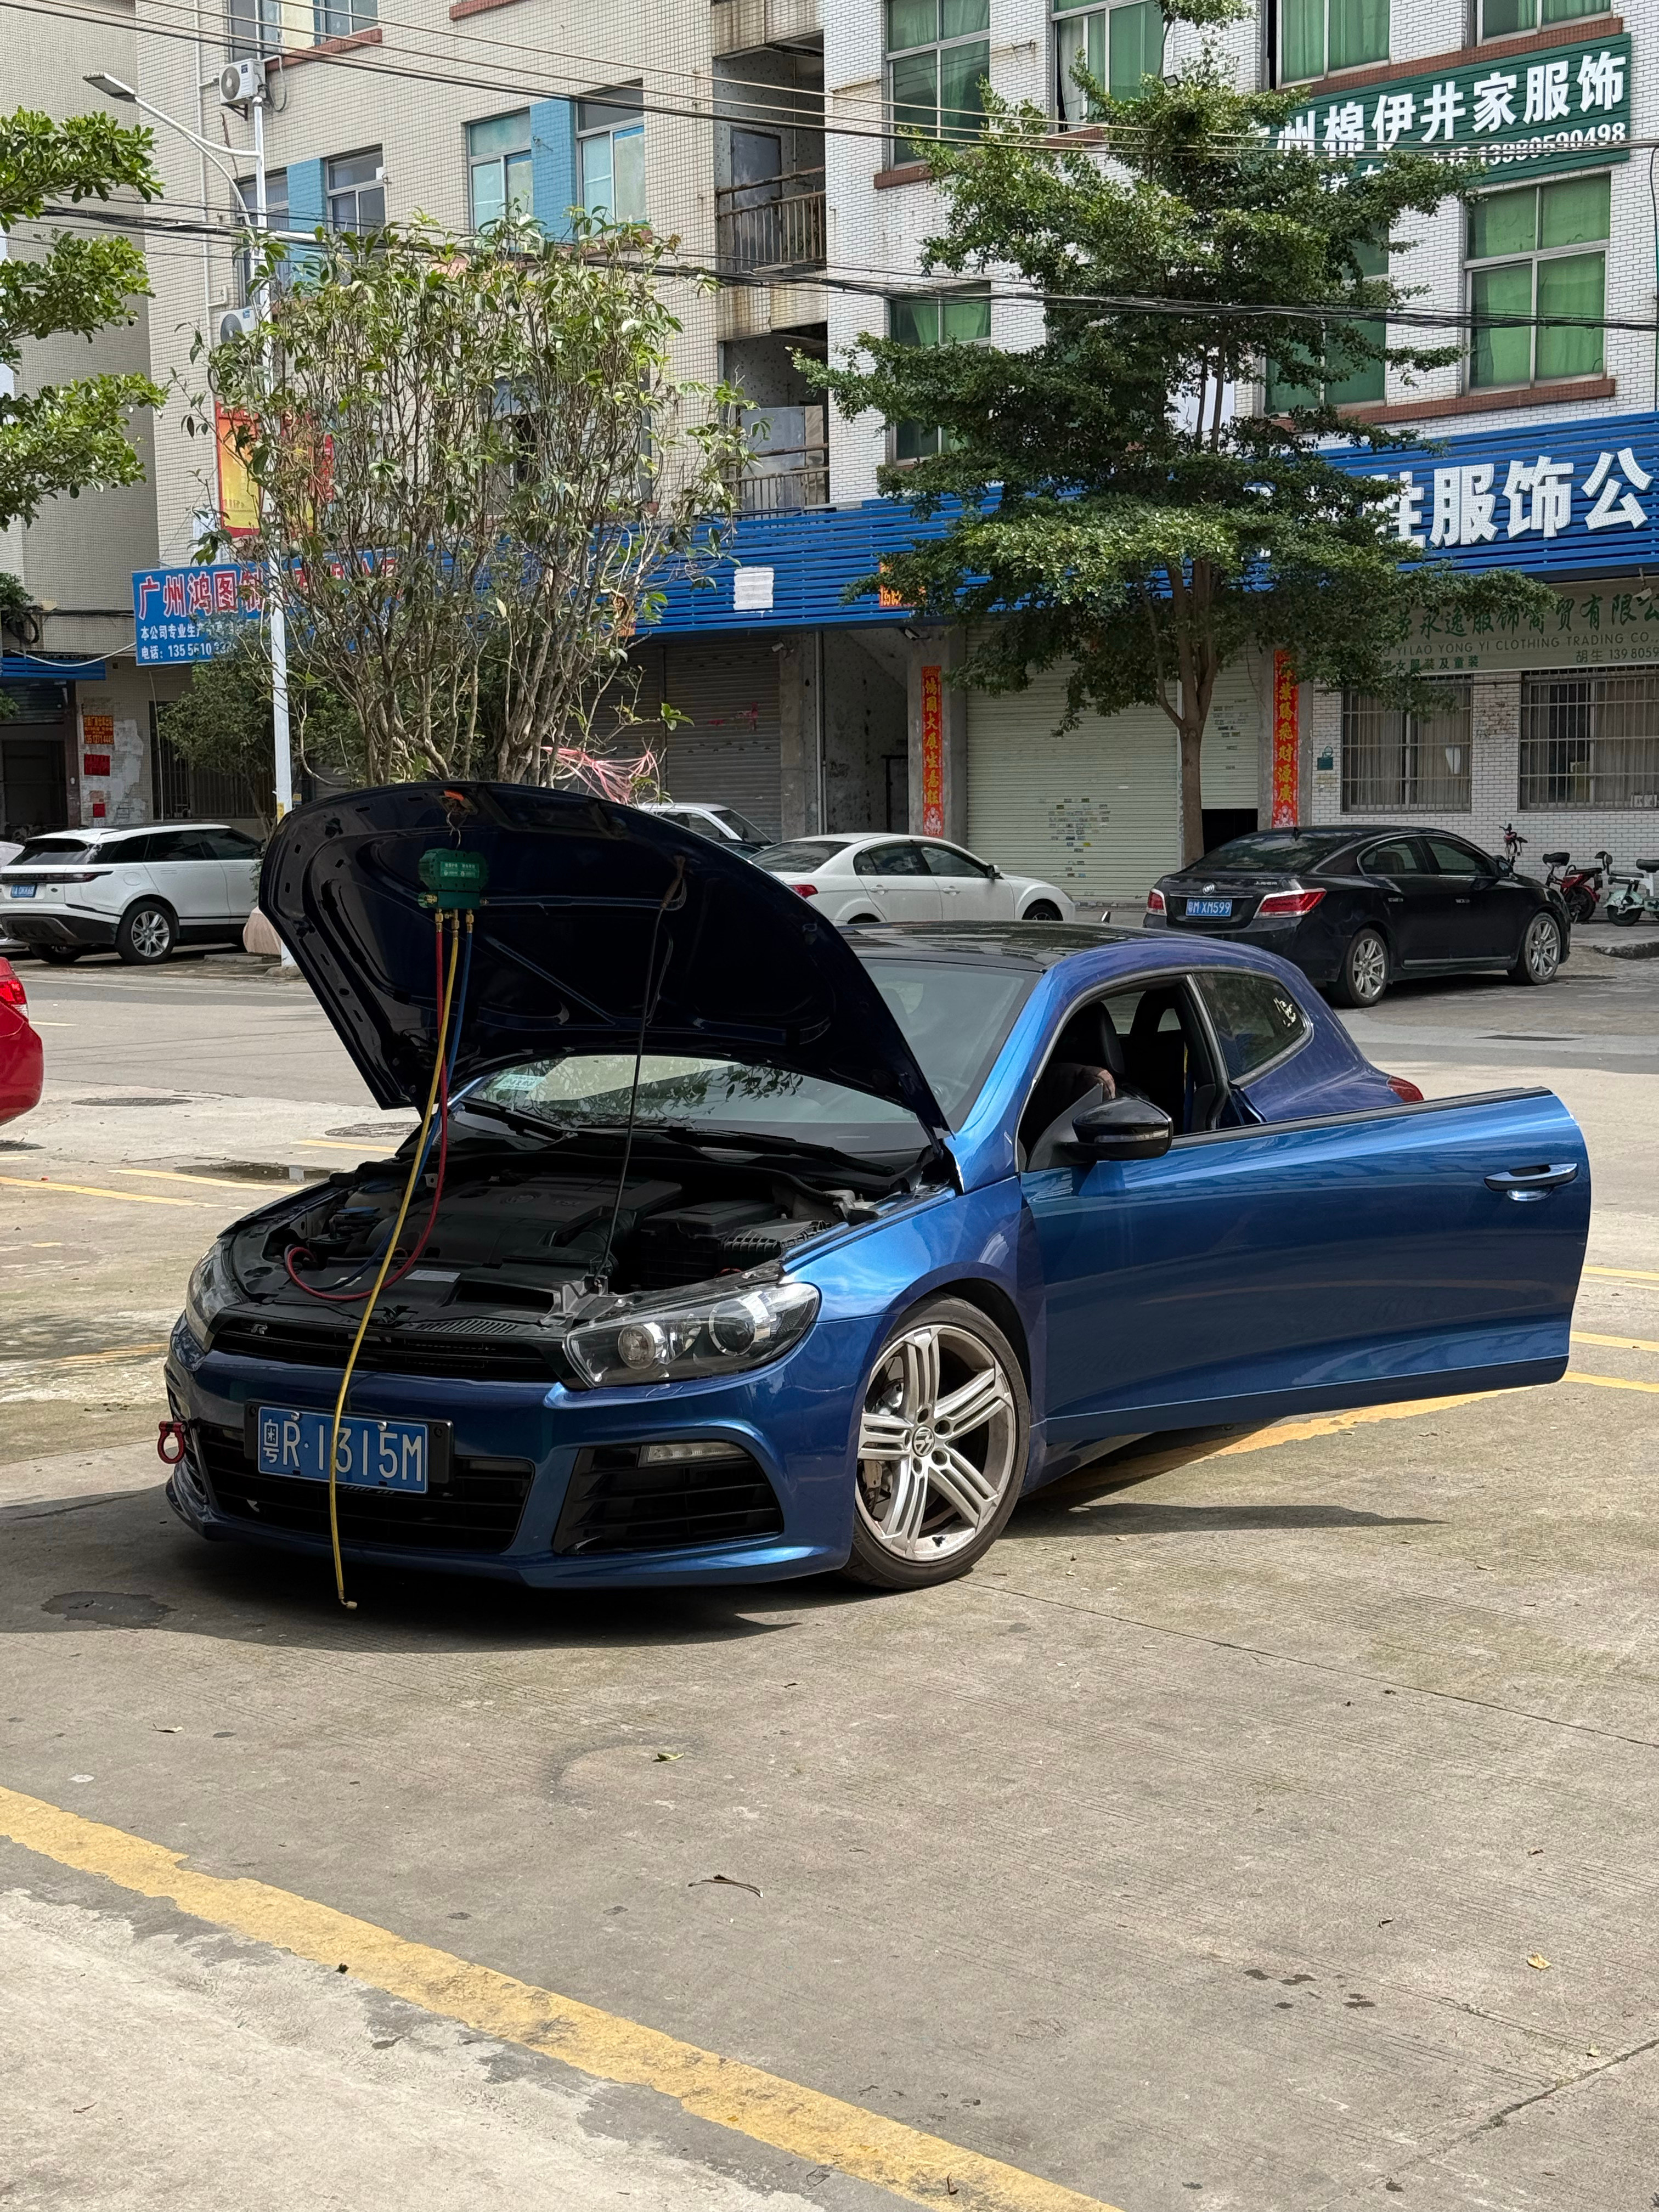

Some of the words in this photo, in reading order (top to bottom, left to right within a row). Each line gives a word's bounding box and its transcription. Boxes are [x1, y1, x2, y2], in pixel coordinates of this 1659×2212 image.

[1249, 51, 1627, 162] 州棉伊井家服饰
[1438, 642, 1472, 654] YONG
[1479, 641, 1489, 651] YI
[1496, 637, 1559, 651] CLOTHING
[1567, 633, 1624, 646] TRADING
[1576, 650, 1604, 663] 胡生
